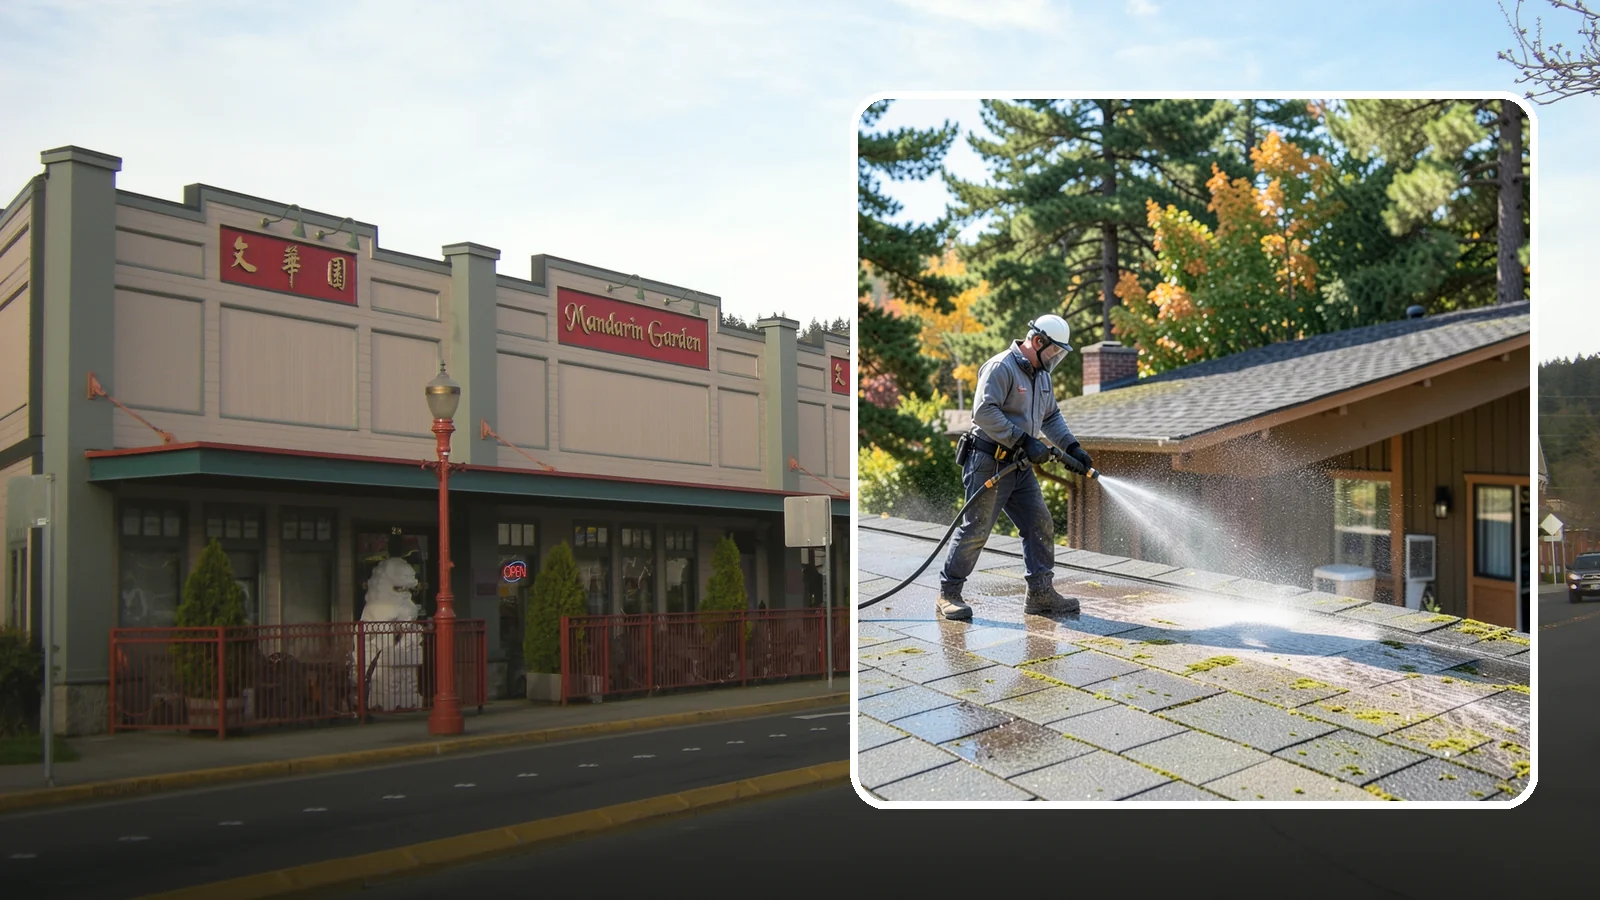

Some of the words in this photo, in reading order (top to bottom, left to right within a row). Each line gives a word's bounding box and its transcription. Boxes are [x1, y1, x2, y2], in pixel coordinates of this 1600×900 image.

[230, 235, 346, 291] 文華園
[564, 302, 644, 341] Mandarin
[648, 320, 701, 352] Garden
[503, 565, 527, 578] OPEN
